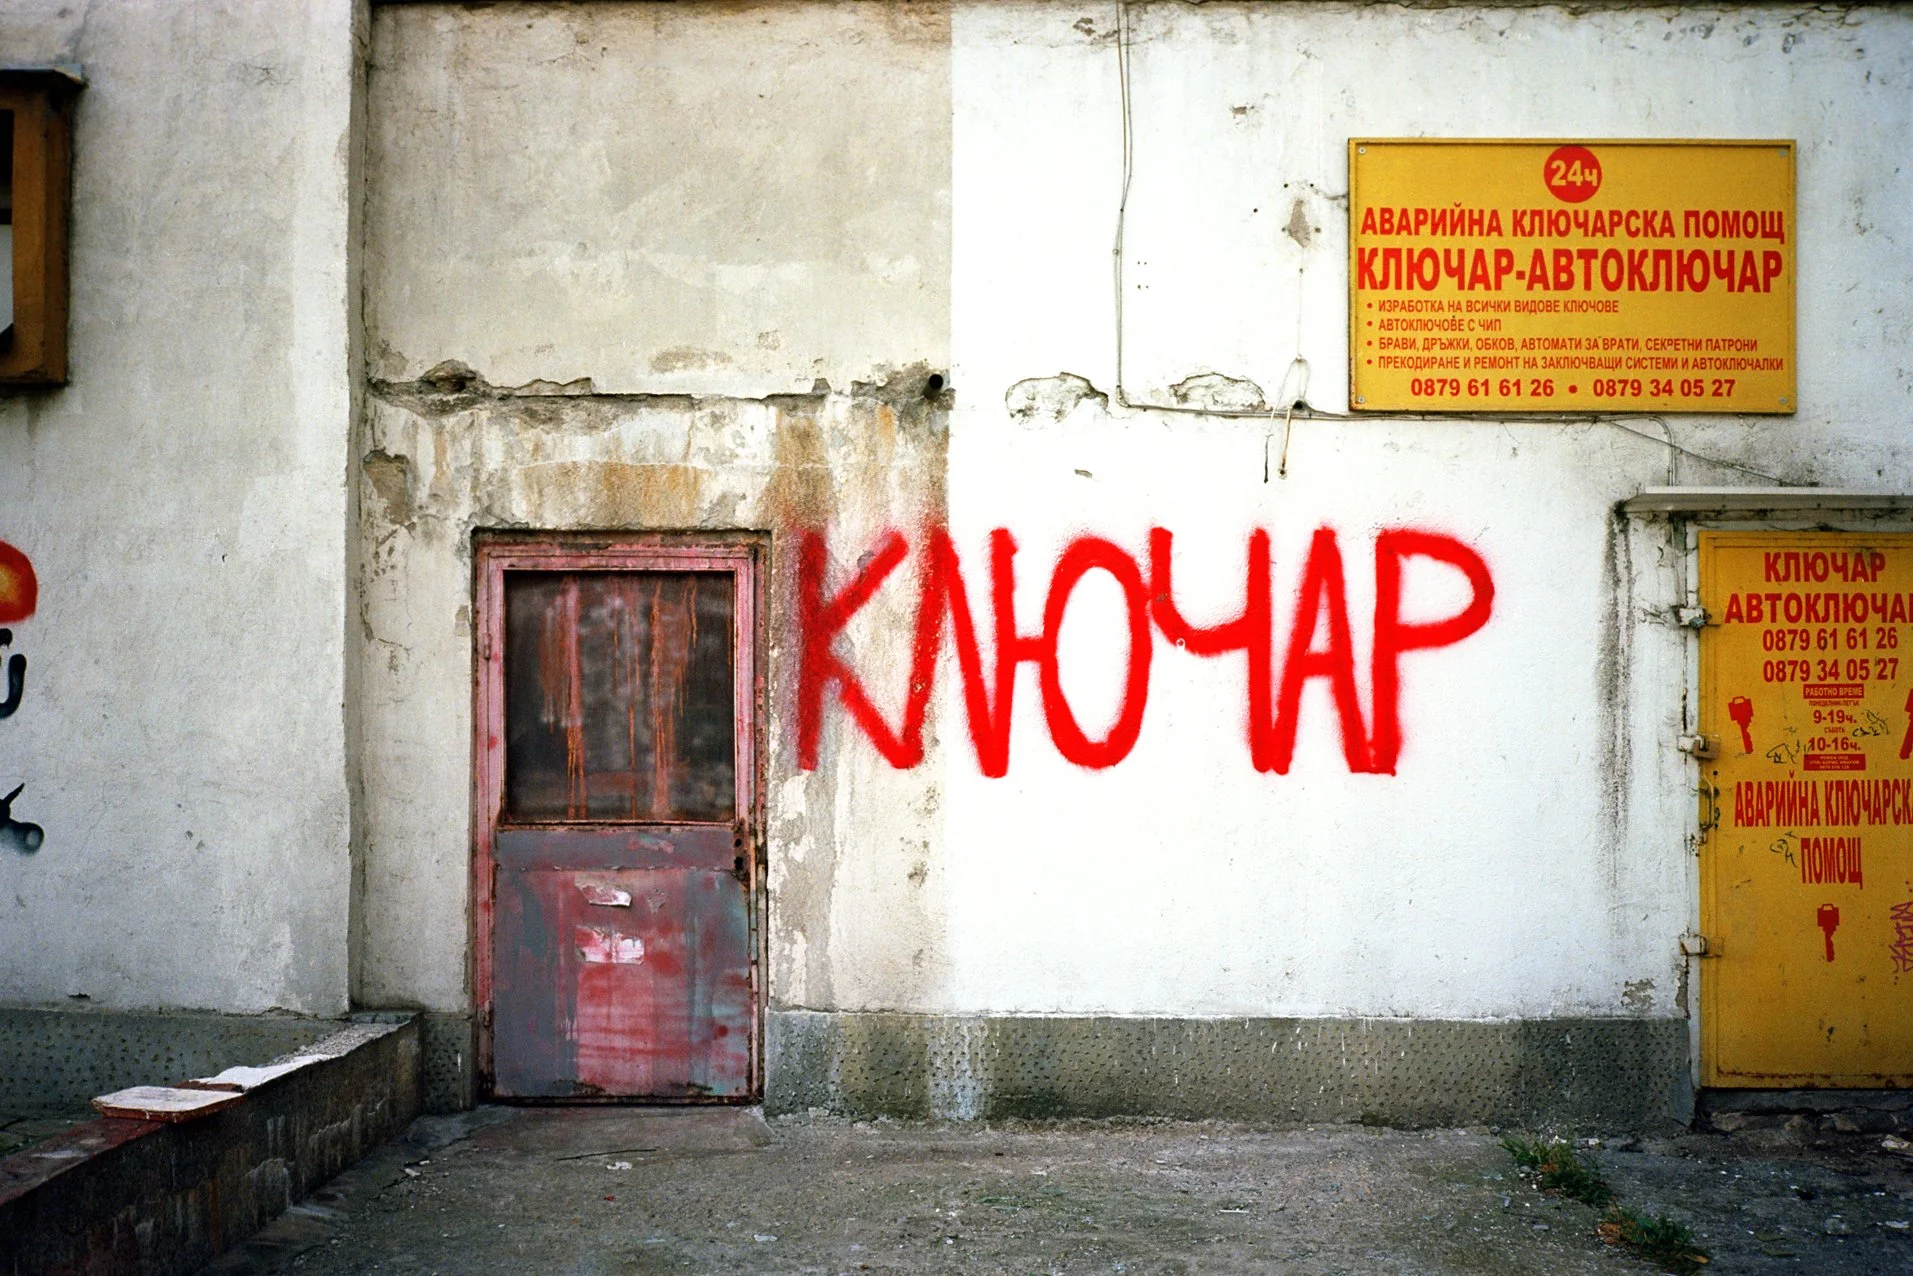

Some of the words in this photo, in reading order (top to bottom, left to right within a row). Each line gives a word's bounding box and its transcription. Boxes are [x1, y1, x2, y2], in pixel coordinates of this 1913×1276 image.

[1550, 159, 1599, 187] 24ч
[1360, 202, 1503, 238] АВАРИЙНА
[1511, 209, 1676, 239] КЛЮЧАРСКА
[1683, 210, 1785, 244] ПОМОЩ
[1357, 247, 1783, 293] КЛЮЧАР-АВТОКЛЮЧАР
[1378, 299, 1445, 313] ИЗРАБОТКА
[1447, 300, 1463, 313] НА
[1465, 300, 1512, 313] ВСИЧКИ
[1514, 300, 1561, 315] ВИДОВЕ
[1563, 300, 1619, 313] КЛЮЧОВЕ
[1378, 318, 1465, 332] АВТОКЛЮЧОВЕ
[1467, 319, 1476, 332] С
[1479, 319, 1502, 332] ЧИП
[1378, 337, 1420, 351] БРАВИ,
[1422, 337, 1473, 353] ДРЪЖКИ,
[1475, 337, 1518, 352] ОБКОВ,
[1521, 338, 1583, 351] АВТОМАТИ
[1585, 338, 1600, 351] ЗА
[1602, 338, 1642, 352] ВРАТИ,
[1645, 338, 1702, 351] СЕКРЕТНИ
[1705, 338, 1758, 352] ПАТРОНИ
[1378, 356, 1460, 371] ПРЕКОДИРАНЕ
[1463, 356, 1471, 369] И
[1474, 356, 1520, 369] РЕМОНТ
[1523, 356, 1538, 369] НА
[1541, 356, 1623, 371] ЗАКЛЮЧВАЩИ
[1625, 357, 1679, 370] СИСТЕМИ
[1681, 357, 1689, 370] И
[1691, 357, 1784, 371] АВТОКЛЮЧАЛКИ
[1410, 378, 1461, 397] 0879
[1467, 378, 1490, 397] 61
[1499, 378, 1522, 397] 61
[1530, 378, 1555, 397] 26
[1592, 379, 1642, 397] 0879
[1649, 379, 1674, 397] 34
[1680, 379, 1705, 397] 05
[1711, 379, 1736, 397] 27
[1764, 551, 1886, 583] КЛЮЧАР
[1762, 628, 1811, 652] 0879
[1816, 628, 1839, 651] 61
[1846, 627, 1869, 650] 61
[1876, 626, 1898, 650] 26
[1763, 659, 1811, 683] 0879
[1816, 659, 1840, 682] 34
[1846, 659, 1870, 681] 05
[1876, 658, 1899, 681] 27
[1805, 687, 1837, 696] РАБОТНО
[1813, 709, 1857, 724] 9-19ч.
[1734, 769, 1820, 828] АВАРИЙНА
[1825, 778, 1913, 827] КЛЮЧАРСК
[1801, 837, 1863, 890] ПОМОЩ
